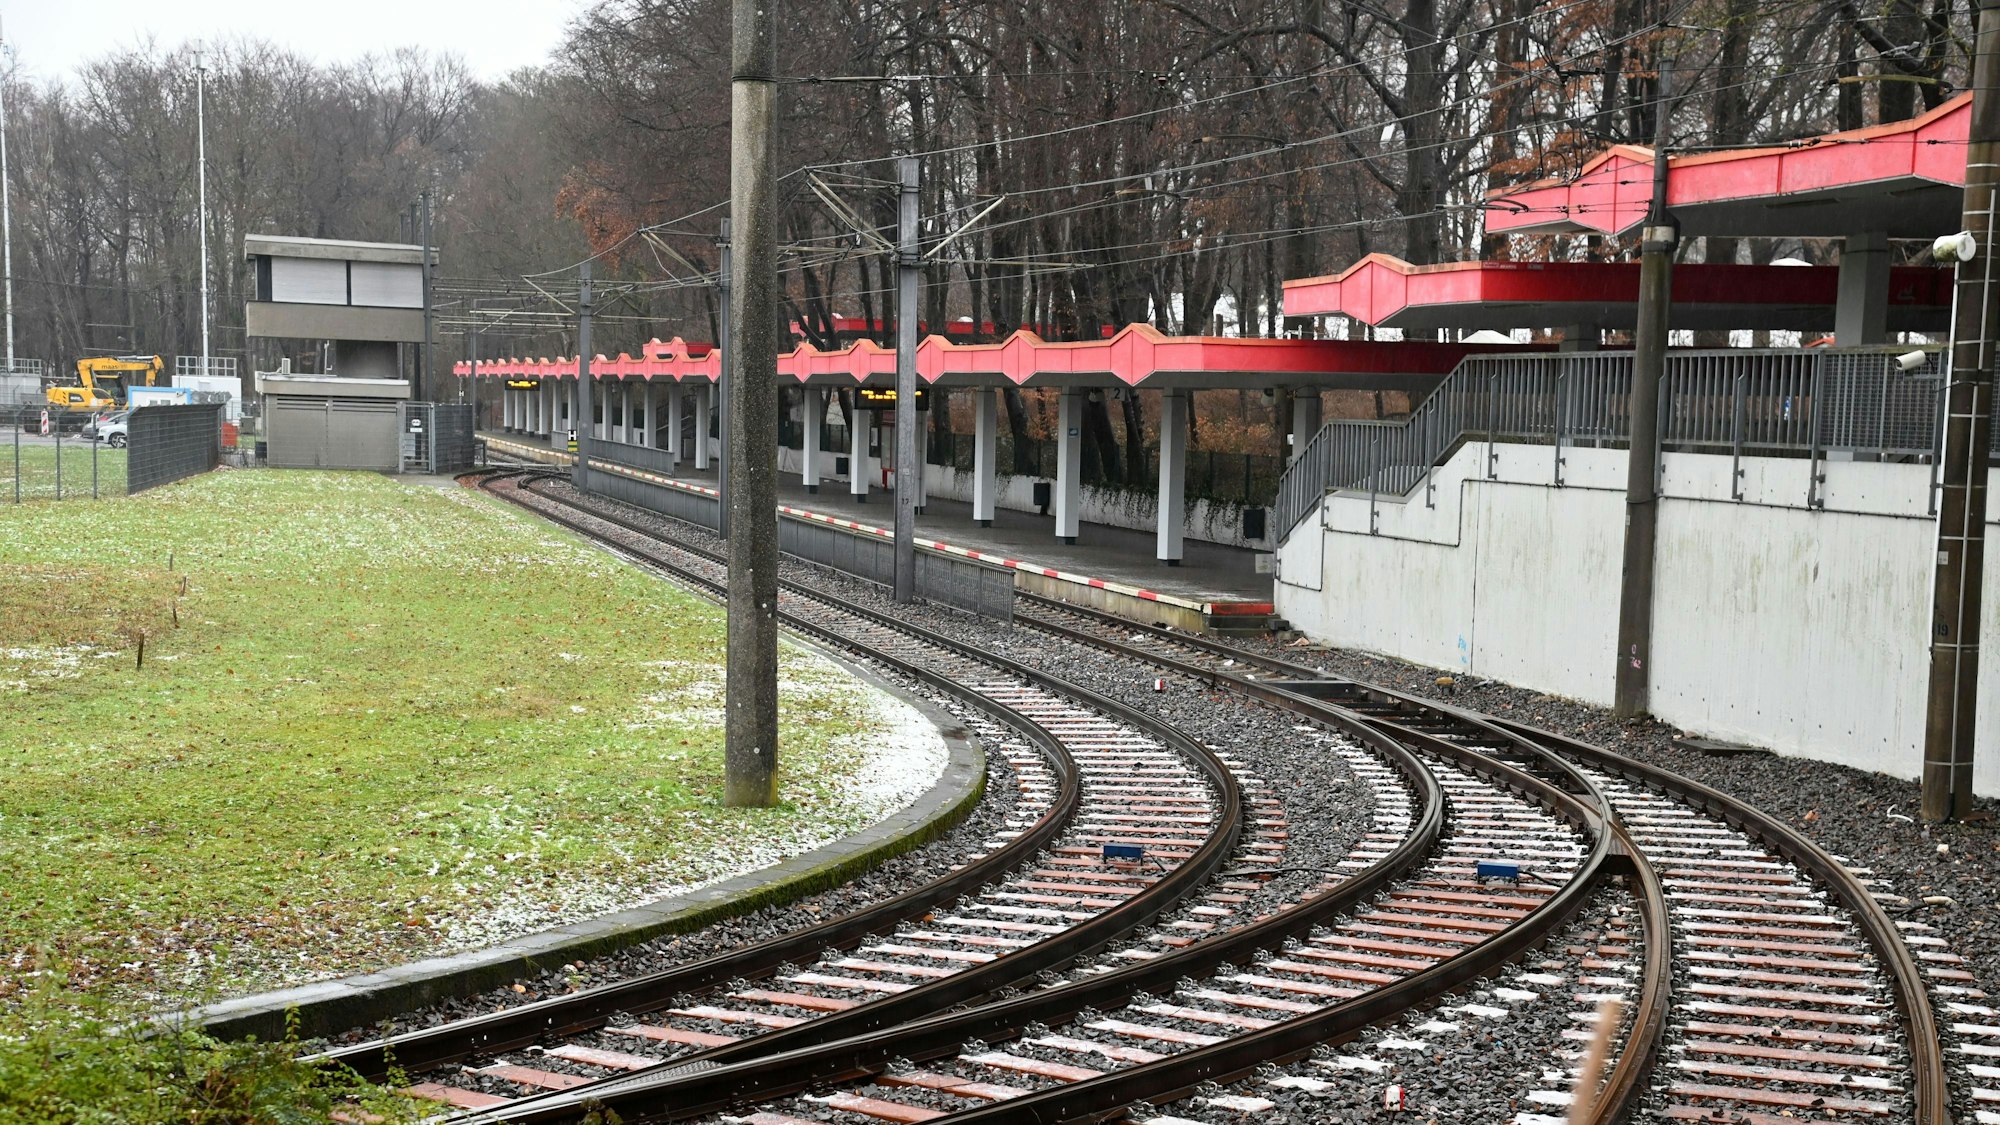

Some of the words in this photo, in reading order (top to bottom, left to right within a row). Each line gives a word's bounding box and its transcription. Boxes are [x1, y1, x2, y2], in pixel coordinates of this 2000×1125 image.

[1114, 387, 1120, 399] 2
[568, 430, 577, 440] H
[1937, 624, 1948, 636] 19
